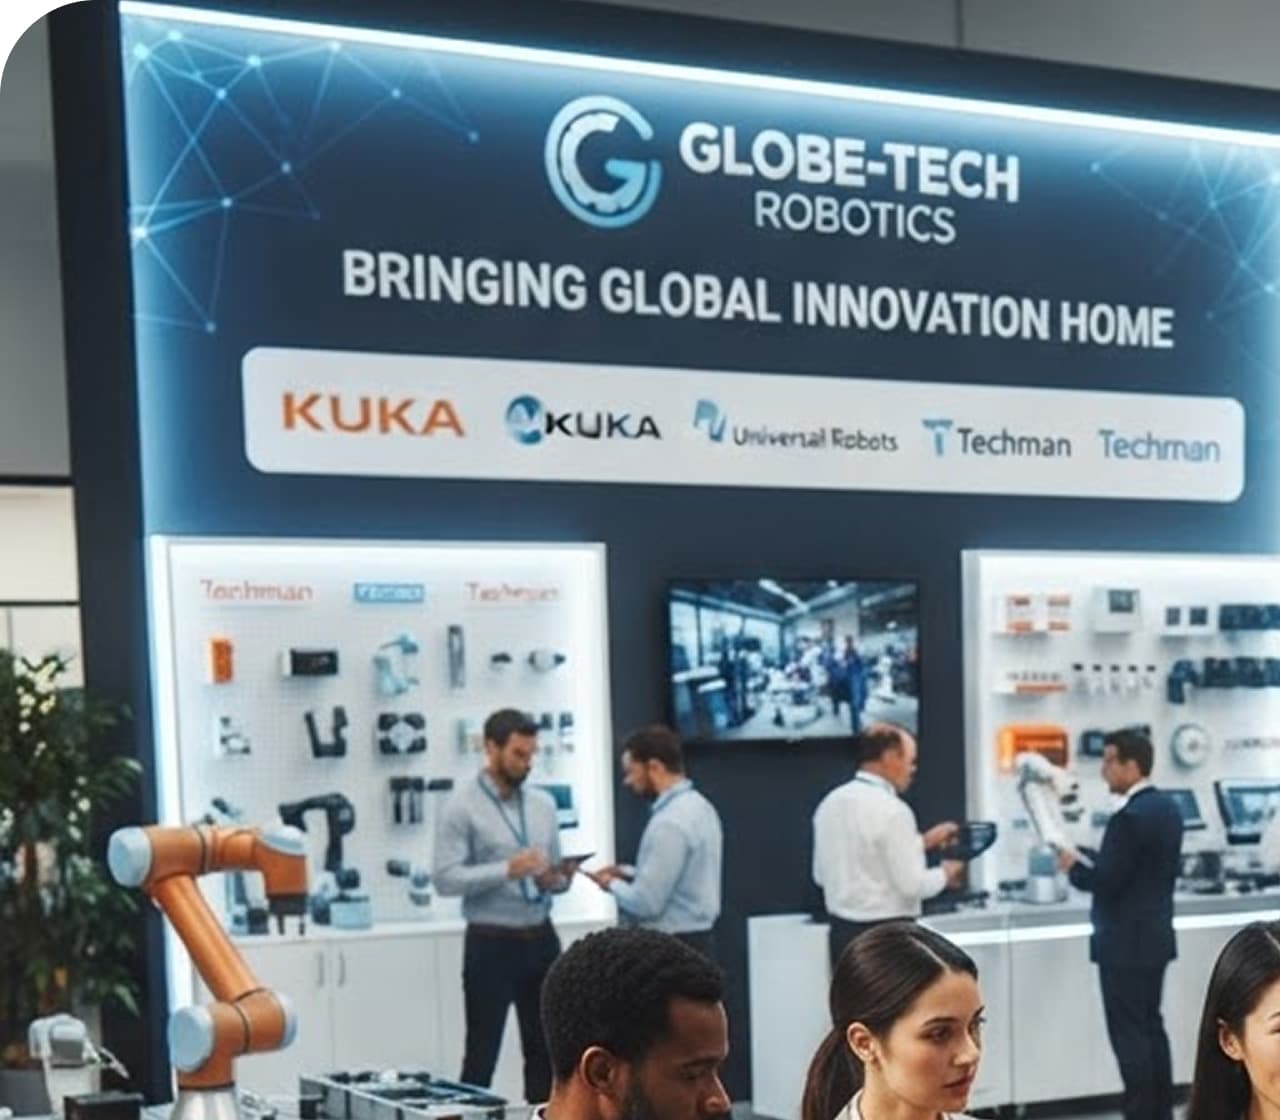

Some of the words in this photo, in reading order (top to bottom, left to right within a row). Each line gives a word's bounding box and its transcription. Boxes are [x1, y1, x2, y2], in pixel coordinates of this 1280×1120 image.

[679, 121, 1020, 203] GLOBE-TECH
[754, 190, 957, 245] ROBOTICS
[342, 248, 588, 312] BRINGING
[600, 267, 782, 324] GLOBAL
[792, 281, 1051, 342] INNOVATION
[1059, 302, 1175, 350] HOME
[281, 391, 466, 438] KUKA
[544, 412, 663, 440] KUKA
[830, 428, 900, 453] Robots
[956, 427, 1073, 459] Techman
[1098, 428, 1222, 463] Techman
